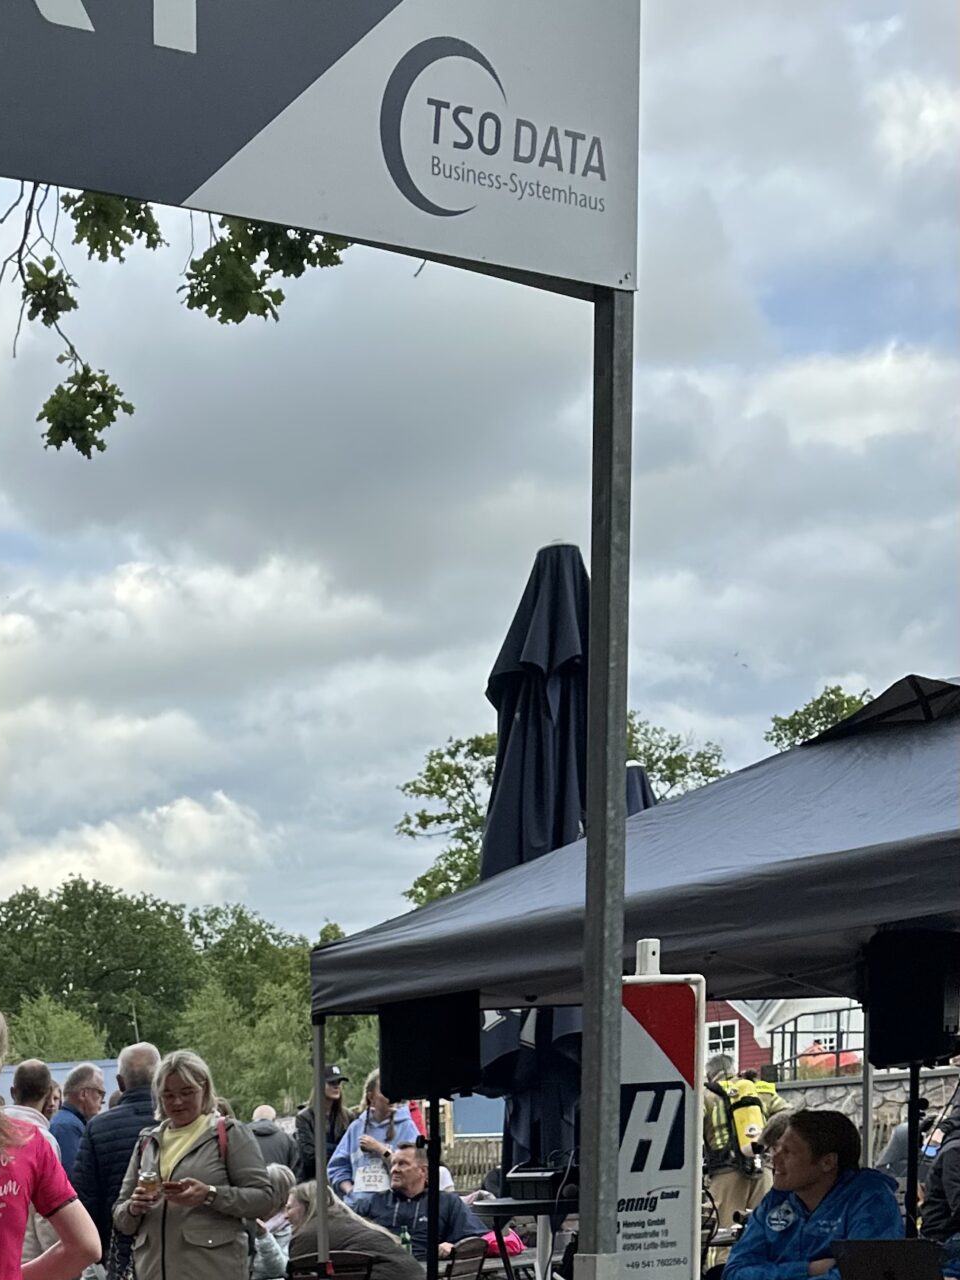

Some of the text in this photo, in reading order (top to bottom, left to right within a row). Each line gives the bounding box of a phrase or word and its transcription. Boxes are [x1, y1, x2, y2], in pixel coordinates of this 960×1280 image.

[427, 97, 607, 182] TSO DATA
[431, 155, 606, 213] Business-Systemhaus
[617, 1195, 659, 1213] ennig
